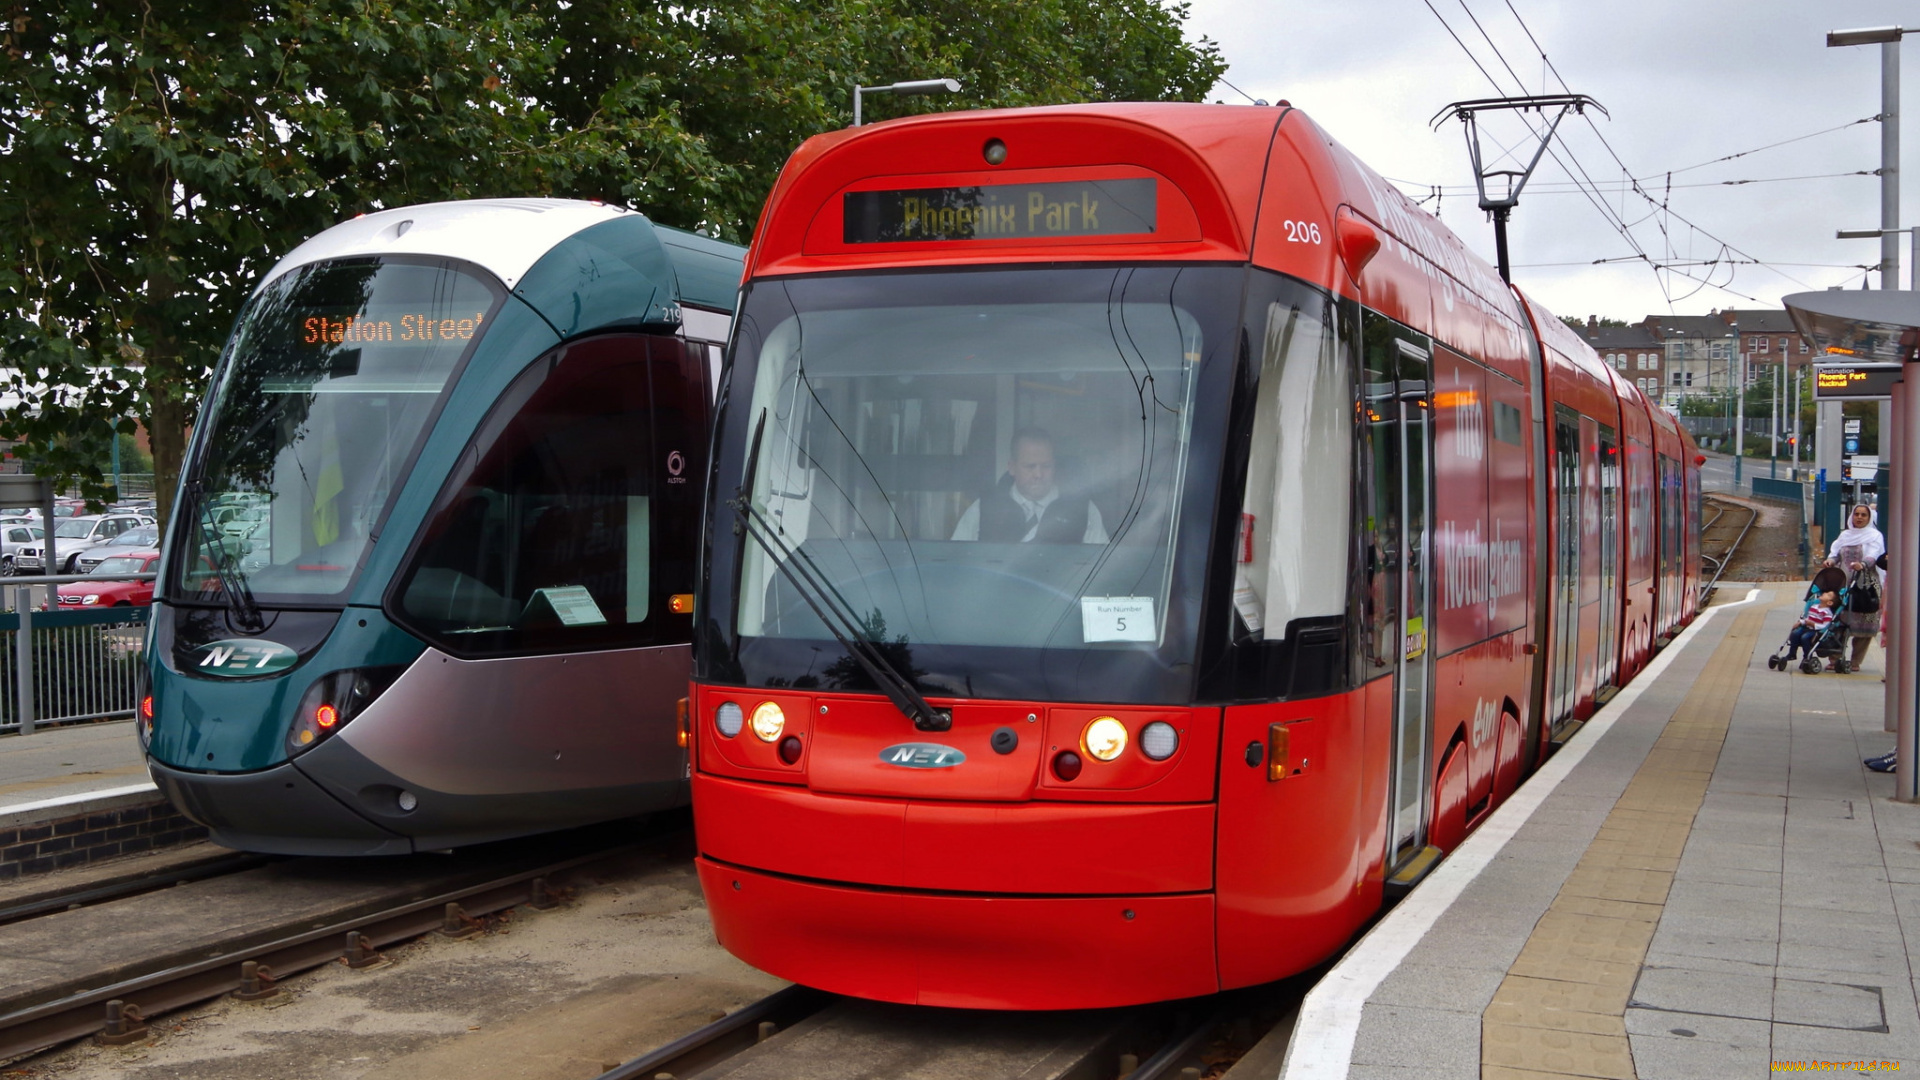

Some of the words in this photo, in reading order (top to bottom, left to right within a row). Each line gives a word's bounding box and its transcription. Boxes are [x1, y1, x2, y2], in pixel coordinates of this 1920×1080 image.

[903, 195, 1016, 237] Phoenix
[1027, 190, 1100, 232] Park
[1283, 219, 1321, 245] 206
[662, 307, 681, 323] 219
[304, 313, 393, 343] Station
[1849, 372, 1867, 380] Park
[1454, 365, 1484, 461] into
[1443, 518, 1522, 620] Nottingham
[1113, 605, 1142, 613] Number
[1116, 617, 1127, 632] 5
[200, 646, 284, 669] NET
[891, 747, 955, 764] NET
